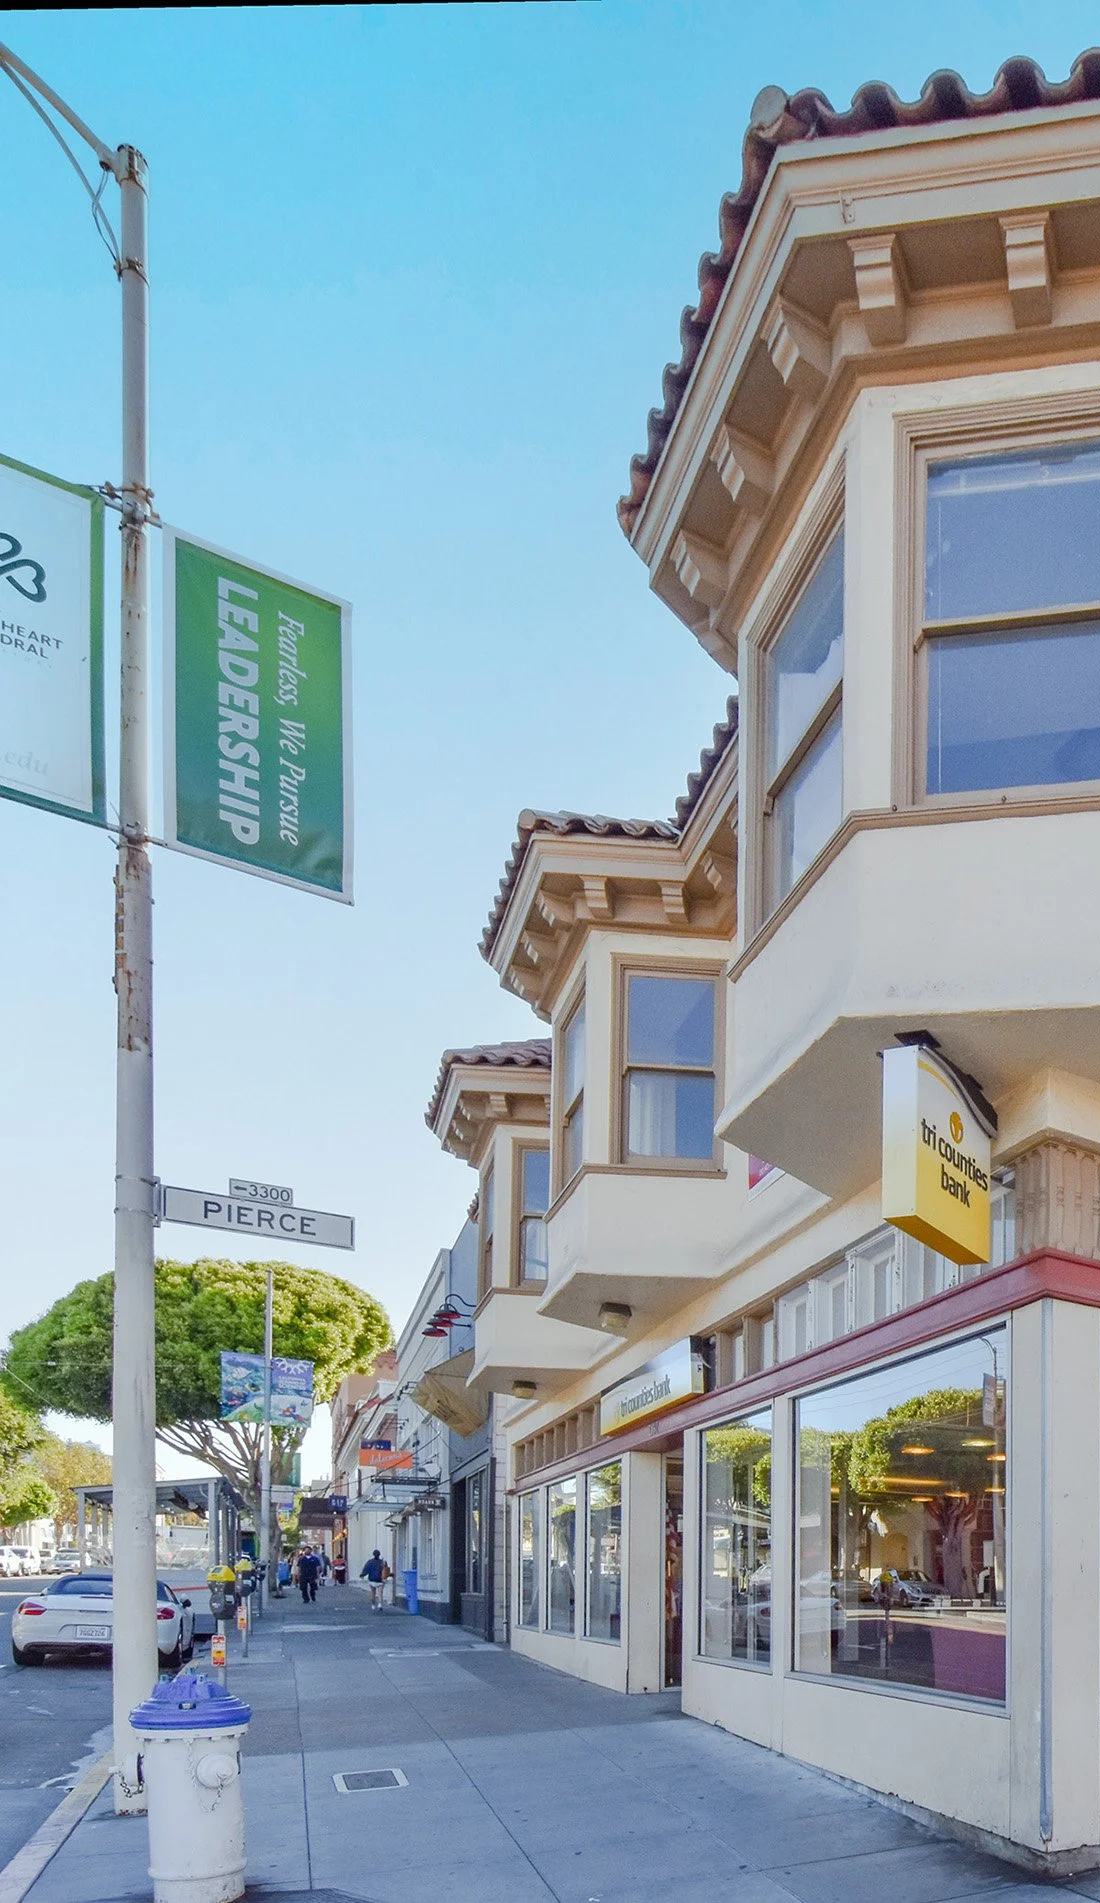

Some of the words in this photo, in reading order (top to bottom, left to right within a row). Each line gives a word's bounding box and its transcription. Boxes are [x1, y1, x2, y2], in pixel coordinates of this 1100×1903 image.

[1, 620, 64, 650] HEART
[273, 610, 308, 706] Fearless,
[217, 576, 260, 846] LEADERSHIP
[278, 718, 306, 756] We
[278, 756, 306, 847] Pursue
[920, 1118, 937, 1151] tri
[938, 1137, 989, 1192] counties
[248, 1184, 291, 1202] 3300
[940, 1163, 971, 1208] bank
[203, 1200, 317, 1236] PIERCE
[620, 1396, 628, 1418] tri
[653, 1374, 671, 1402] bank
